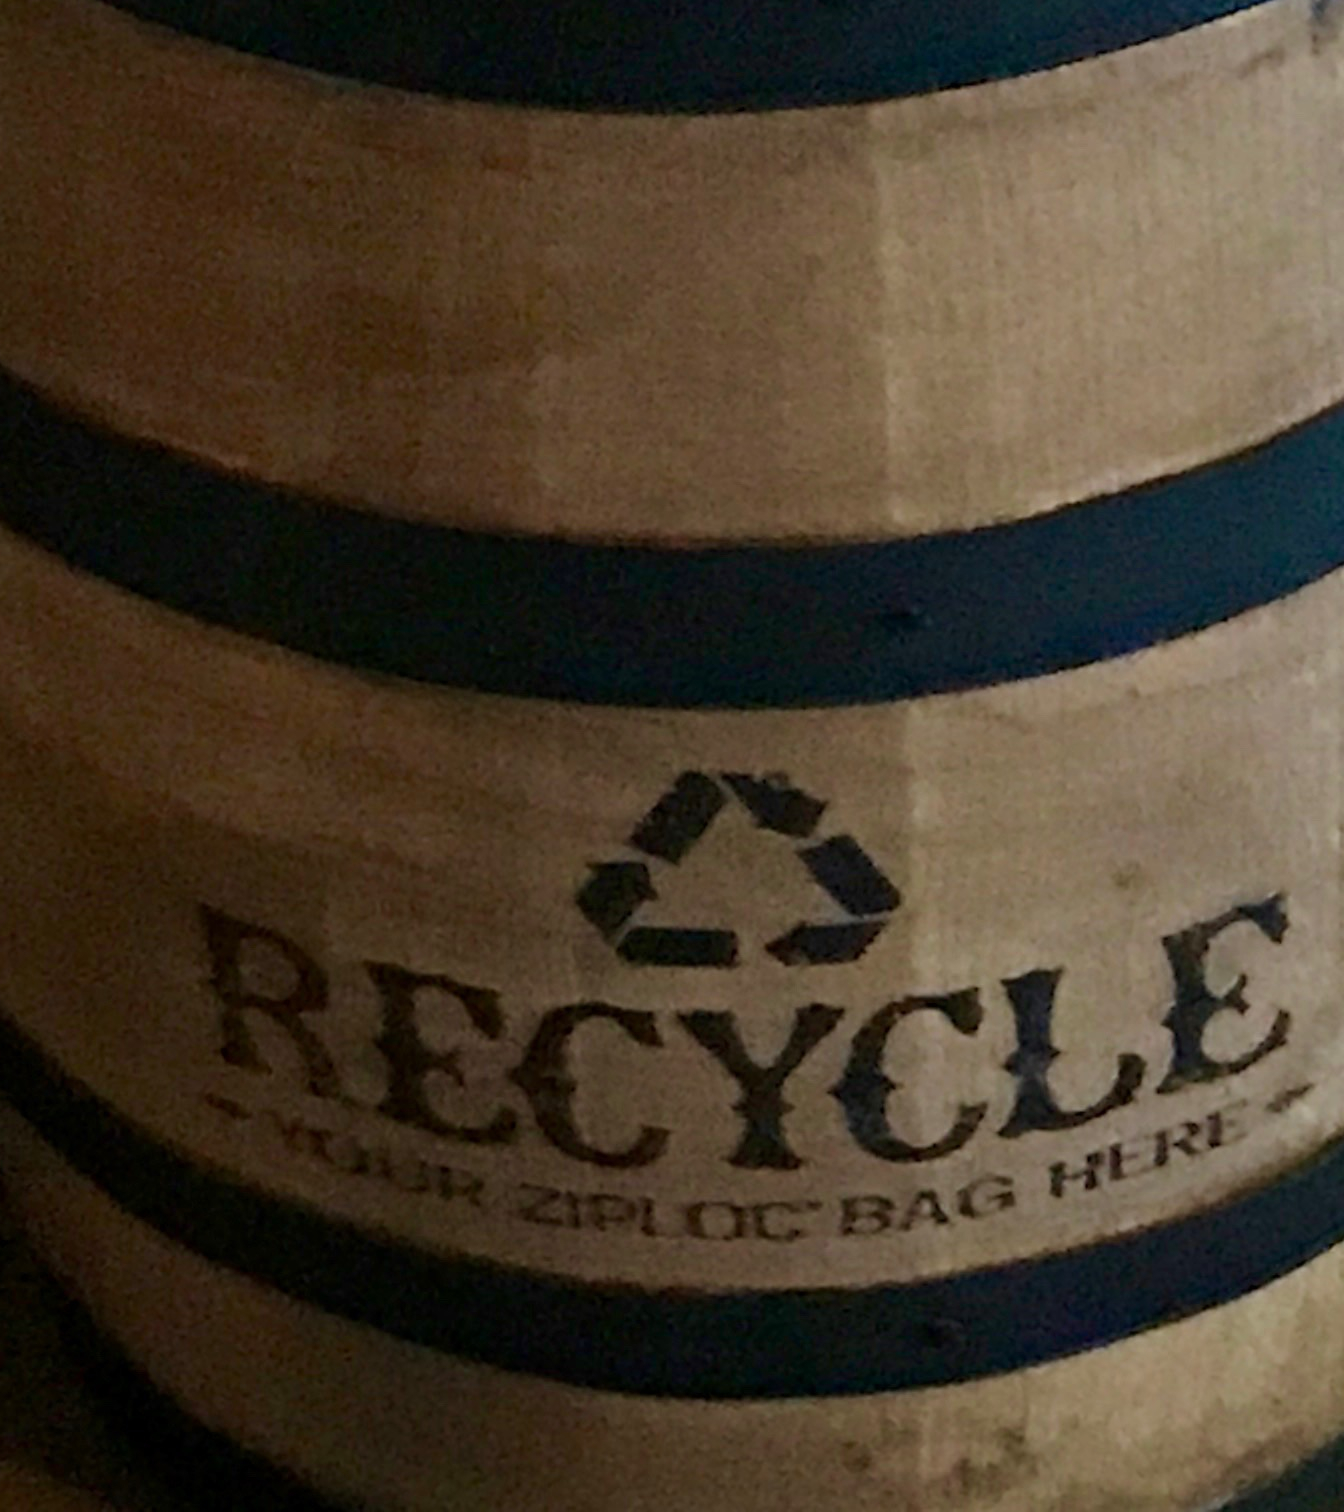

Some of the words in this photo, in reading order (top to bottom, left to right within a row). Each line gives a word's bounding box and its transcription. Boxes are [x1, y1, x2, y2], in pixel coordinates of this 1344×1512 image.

[197, 890, 1294, 1173] RECYCLE
[262, 1109, 484, 1208] YOUR
[517, 1182, 806, 1245] ZIPLOC
[839, 1175, 1016, 1239] BAG
[1048, 1096, 1248, 1204] HERE
